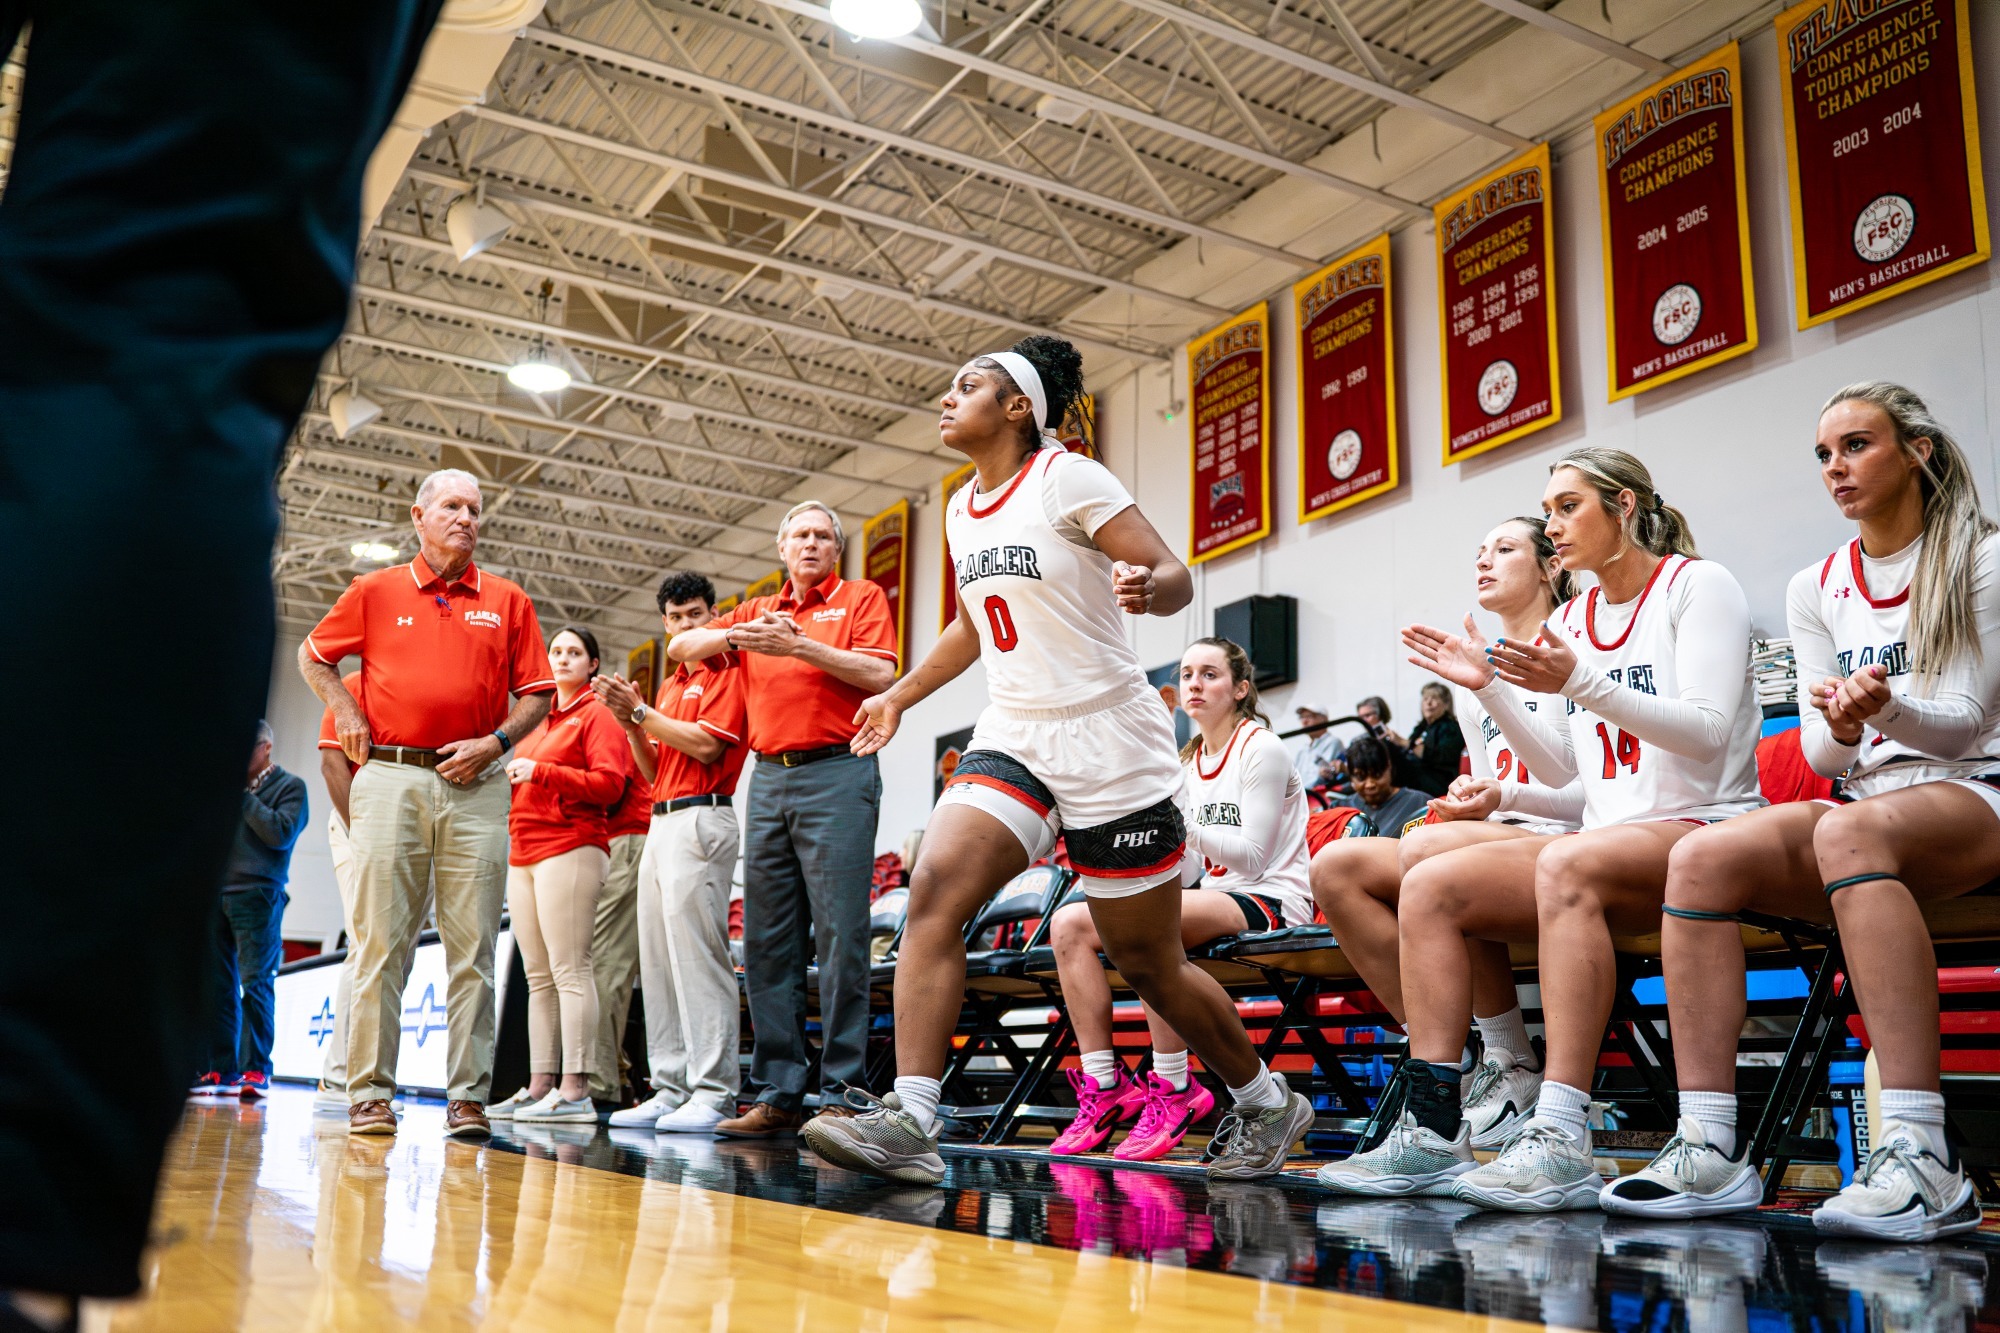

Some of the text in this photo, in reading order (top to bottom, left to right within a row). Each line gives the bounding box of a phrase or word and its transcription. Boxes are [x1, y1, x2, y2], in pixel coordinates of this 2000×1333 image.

[1804, 20, 1942, 102] TOURNAMENT
[1806, 0, 1935, 78] CONFERENCE
[1817, 51, 1930, 120] CHAMPIONS
[1604, 66, 1733, 169] FLAGLER
[1833, 102, 1923, 158] 2003 2004
[1619, 121, 1719, 185] CONFERENCE
[1624, 145, 1714, 203] CHAMPIONS
[1442, 165, 1543, 254] FLAGLER
[1637, 205, 1709, 250] 2004 2005
[1867, 211, 1903, 248] FSC
[1453, 214, 1533, 270] CONFERENCE
[1458, 237, 1530, 286] CHAMPIONS
[1302, 255, 1384, 330] FLAGLER
[1829, 277, 1865, 303] MEN'S
[1869, 245, 1950, 287] BASKETBALL
[1310, 298, 1376, 344] CONFERENCE
[1313, 317, 1372, 360] CHAMPIONS
[1663, 301, 1691, 330] FSC
[1193, 320, 1263, 386] FLAGLER
[1632, 357, 1662, 379] MEN'S
[1664, 332, 1728, 367] BASKETBALL
[1451, 399, 1549, 450] WOMEN'S CROSS COUNTRY
[984, 594, 1019, 653] 0
[1596, 722, 1642, 780] 14
[1113, 829, 1159, 848] PBC
